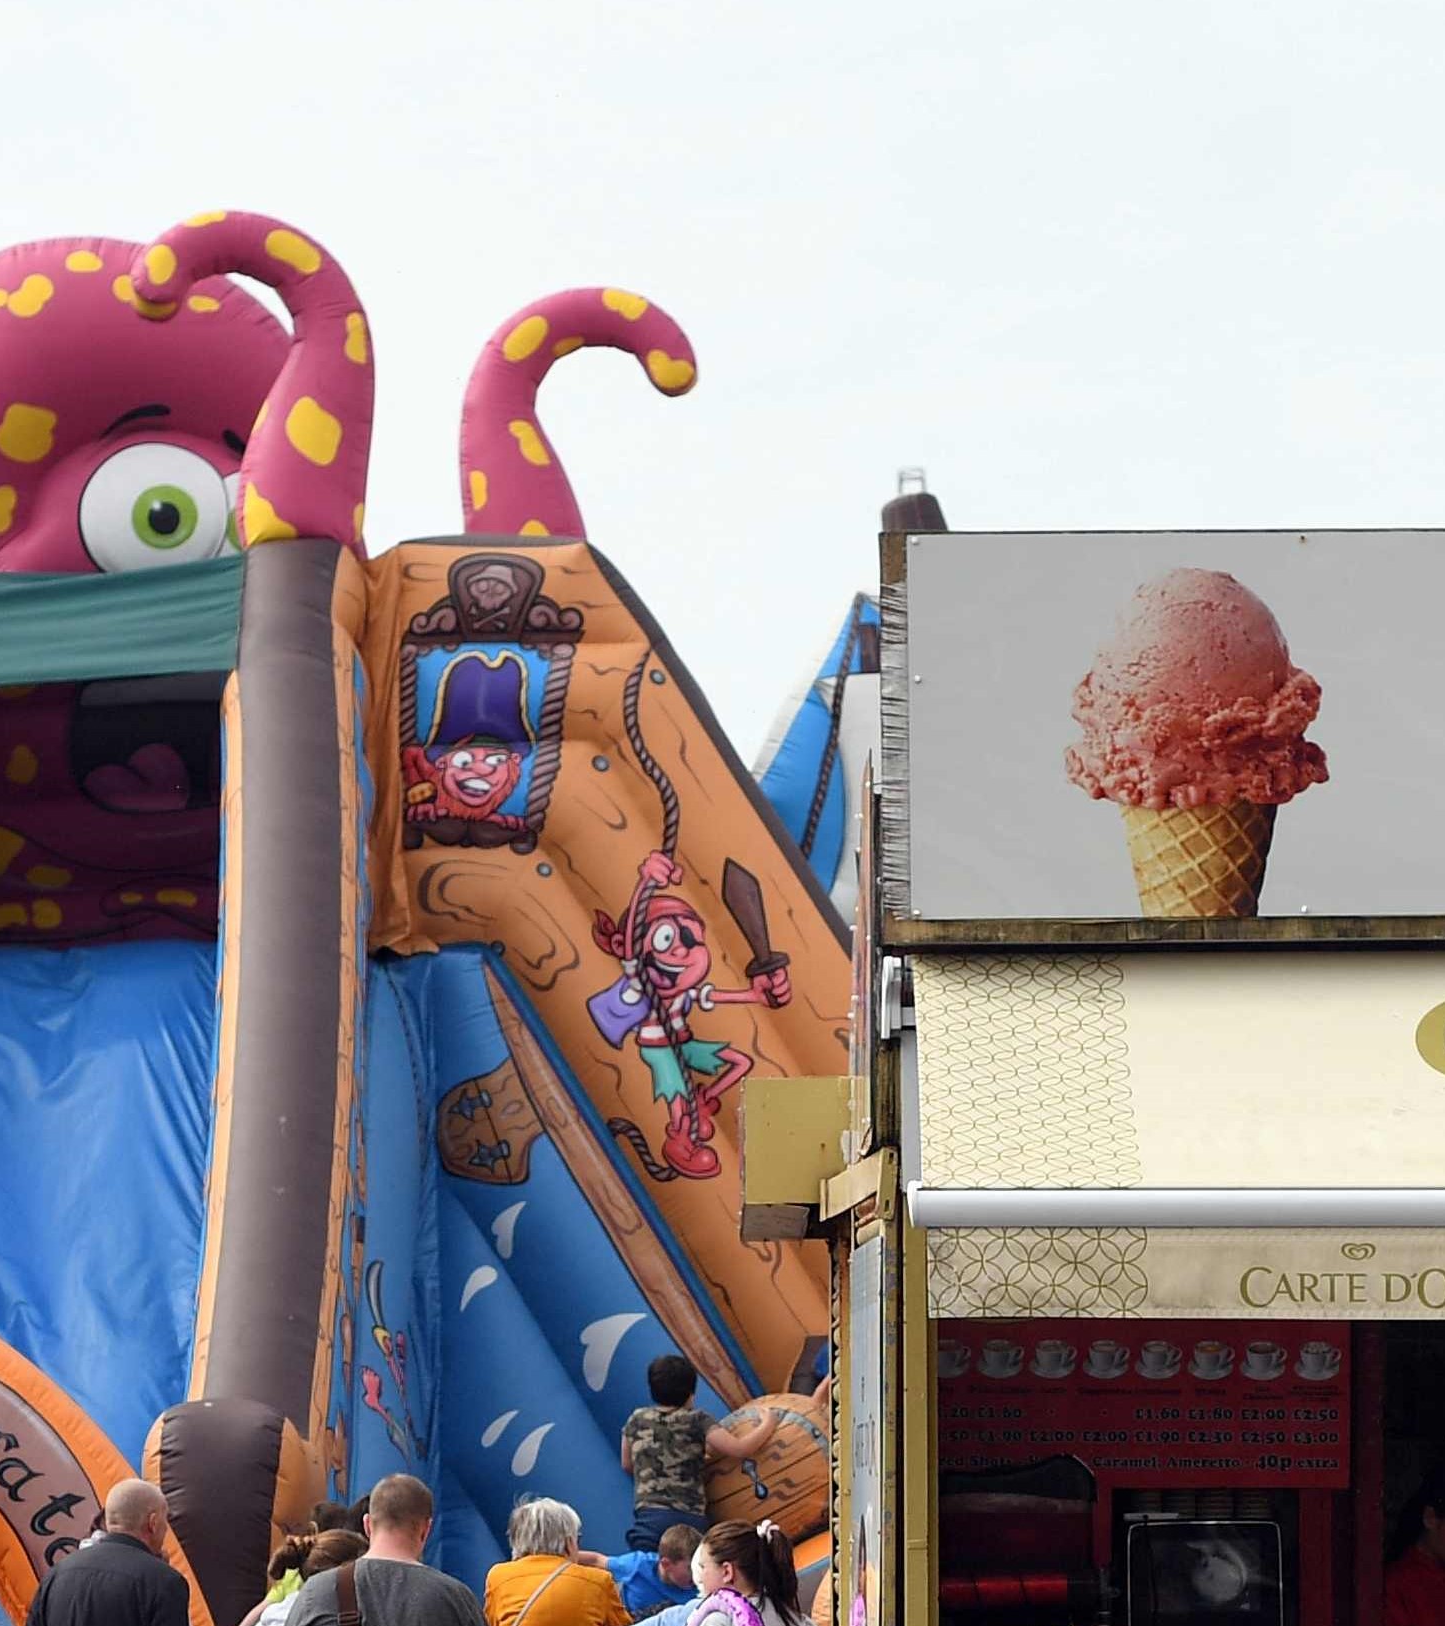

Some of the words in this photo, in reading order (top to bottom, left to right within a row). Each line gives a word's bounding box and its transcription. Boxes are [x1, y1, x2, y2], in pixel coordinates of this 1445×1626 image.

[1239, 1267, 1368, 1309] CARTE
[1242, 1409, 1286, 1419] £2.00
[1294, 1409, 1339, 1420] £2.50
[1030, 1431, 1074, 1442] £2.00
[1083, 1431, 1128, 1442] £2.00
[1297, 1458, 1339, 1468] extra
